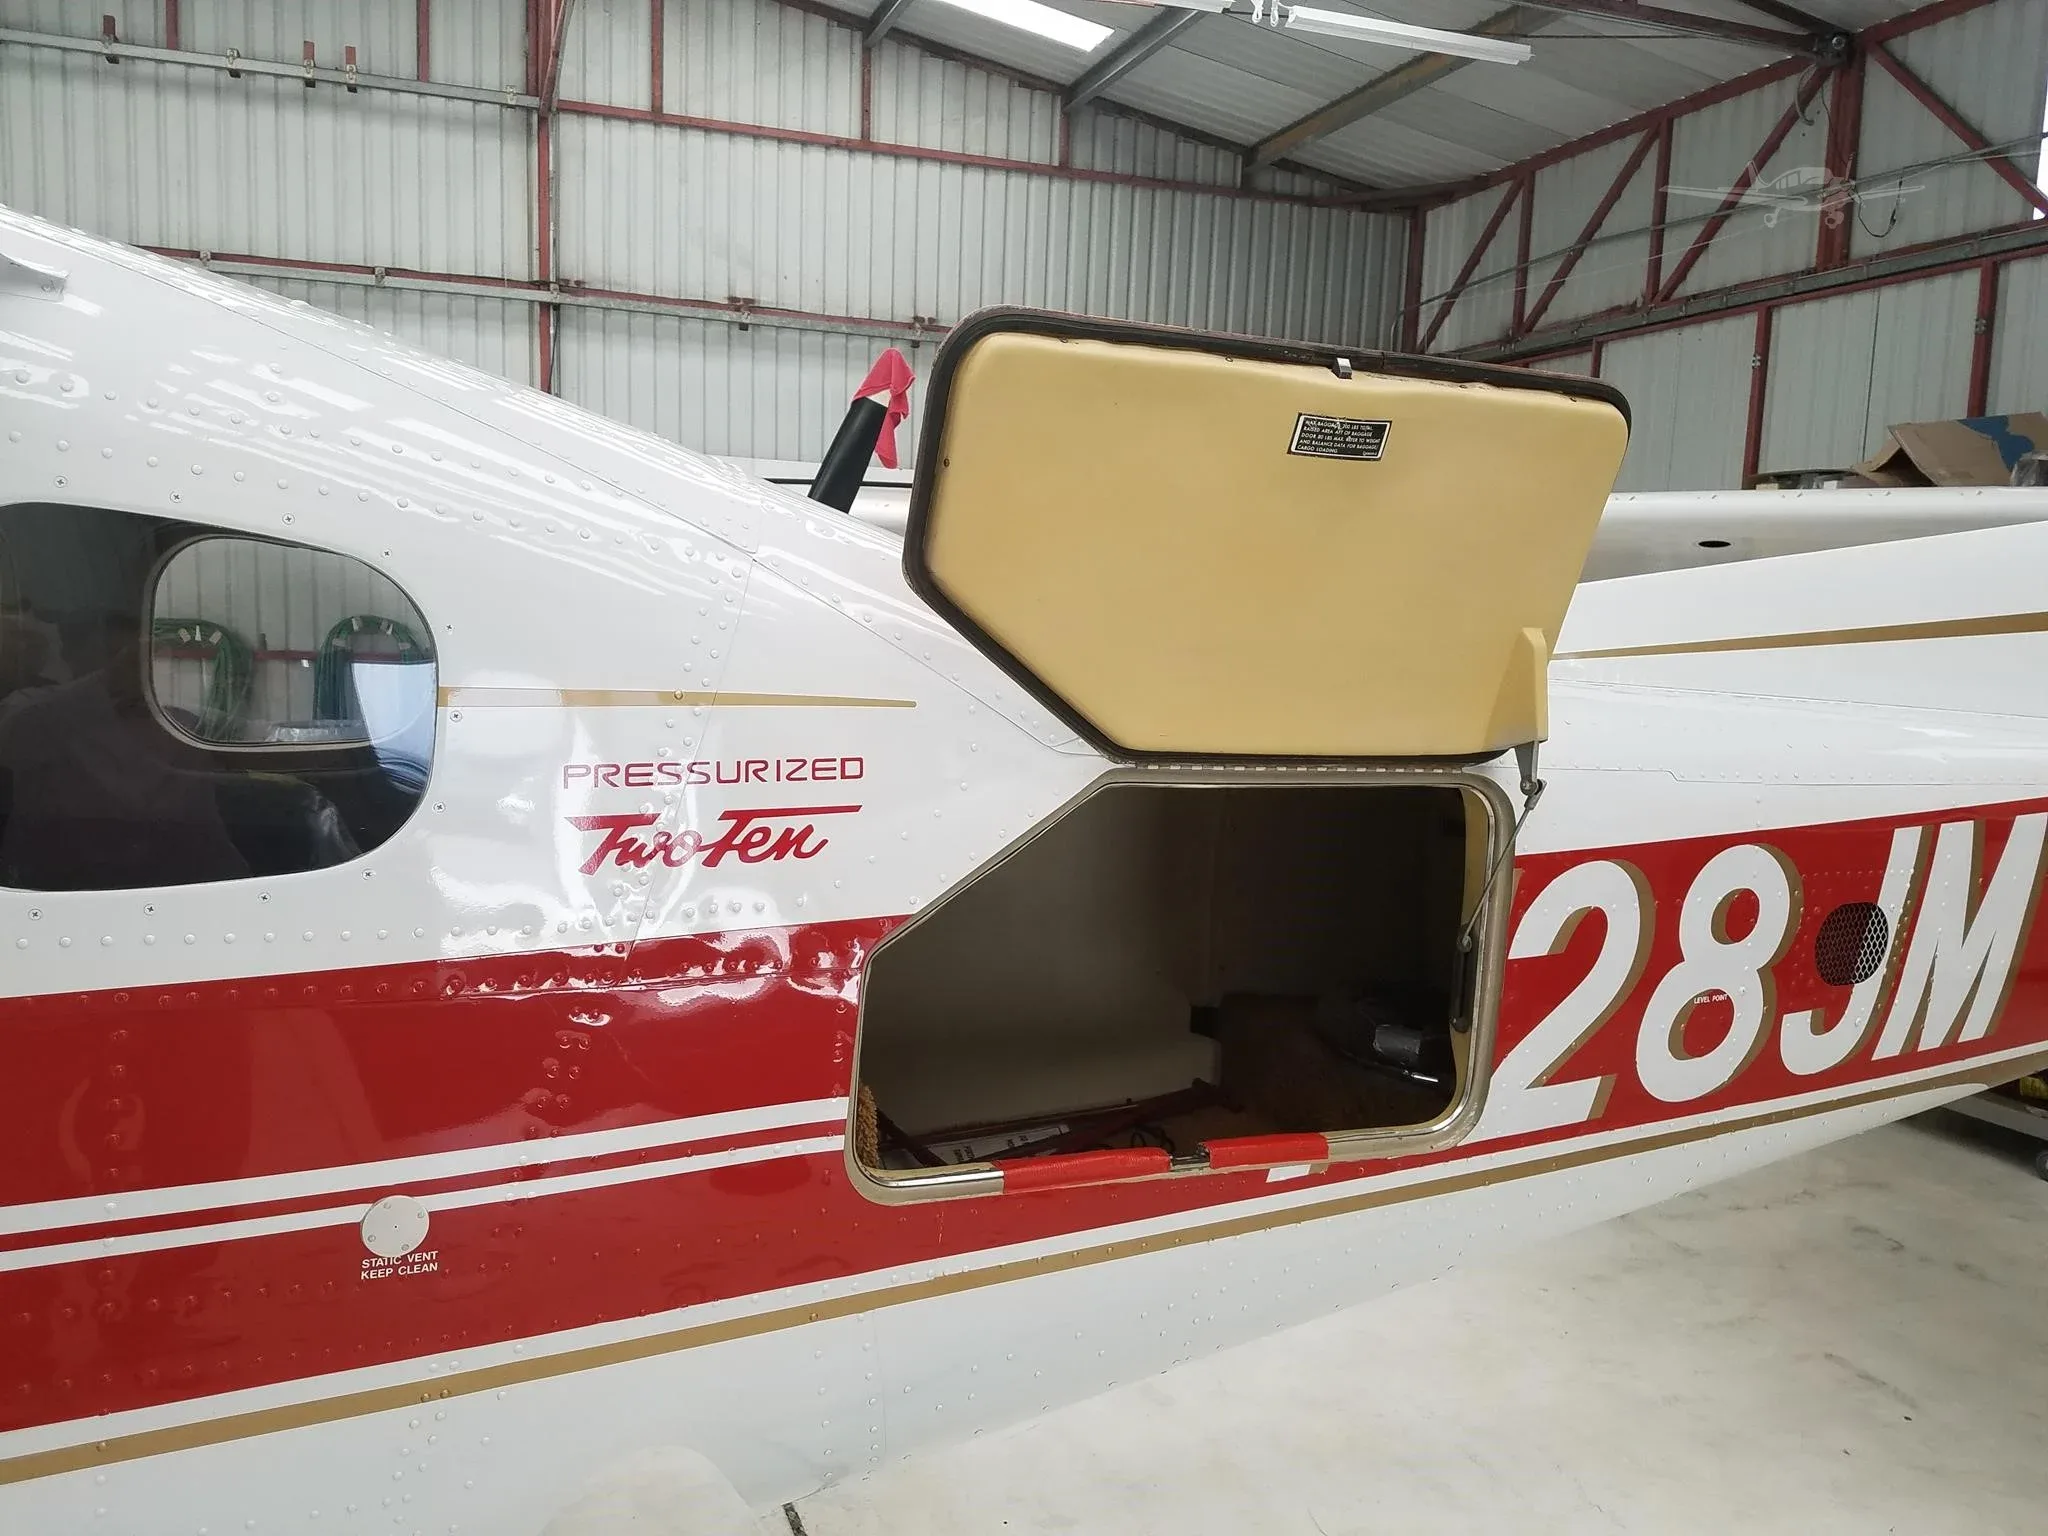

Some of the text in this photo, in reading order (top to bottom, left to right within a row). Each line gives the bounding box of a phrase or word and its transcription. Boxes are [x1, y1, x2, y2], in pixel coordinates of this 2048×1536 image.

[563, 757, 864, 789] PRESSURIZED
[1693, 993, 1727, 1004] LEVEL POINT
[361, 1250, 438, 1269] STATIC VENT
[361, 1262, 438, 1280] KEEP CLEAN
